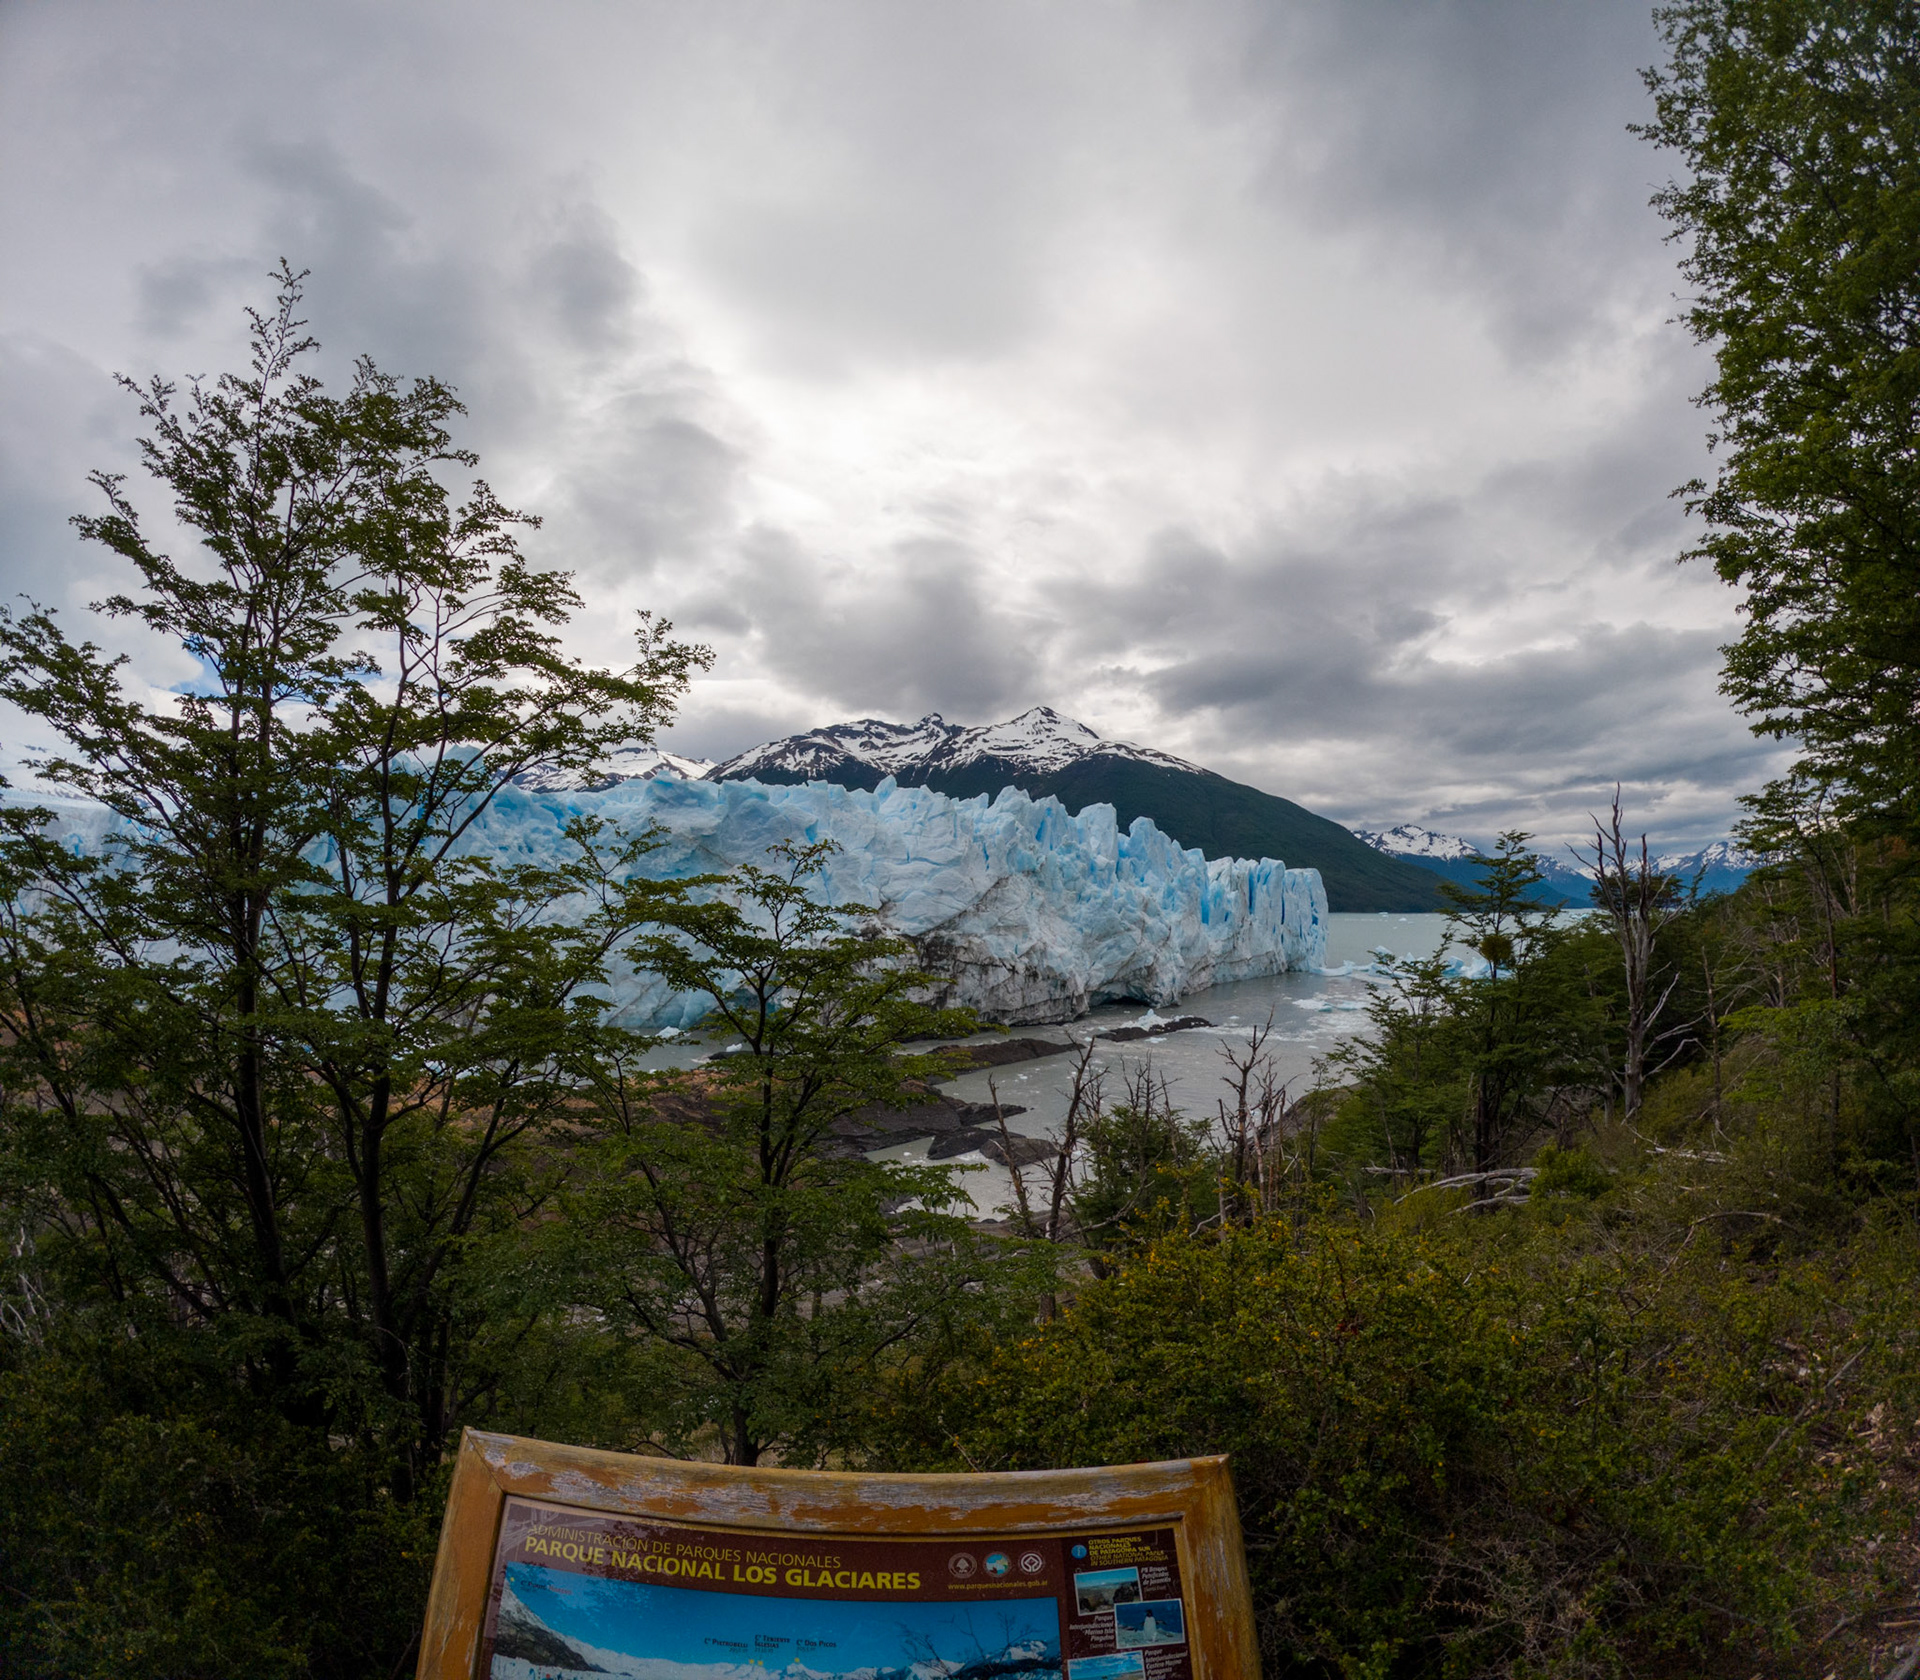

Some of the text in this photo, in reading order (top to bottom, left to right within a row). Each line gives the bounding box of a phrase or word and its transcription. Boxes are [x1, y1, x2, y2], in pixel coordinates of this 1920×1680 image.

[525, 1536, 921, 1590] PARQUE NACIONAL LOS GLACIARES
[528, 1524, 841, 1569] ADMINISTRACIÓN DE PARQUES NACIONALES
